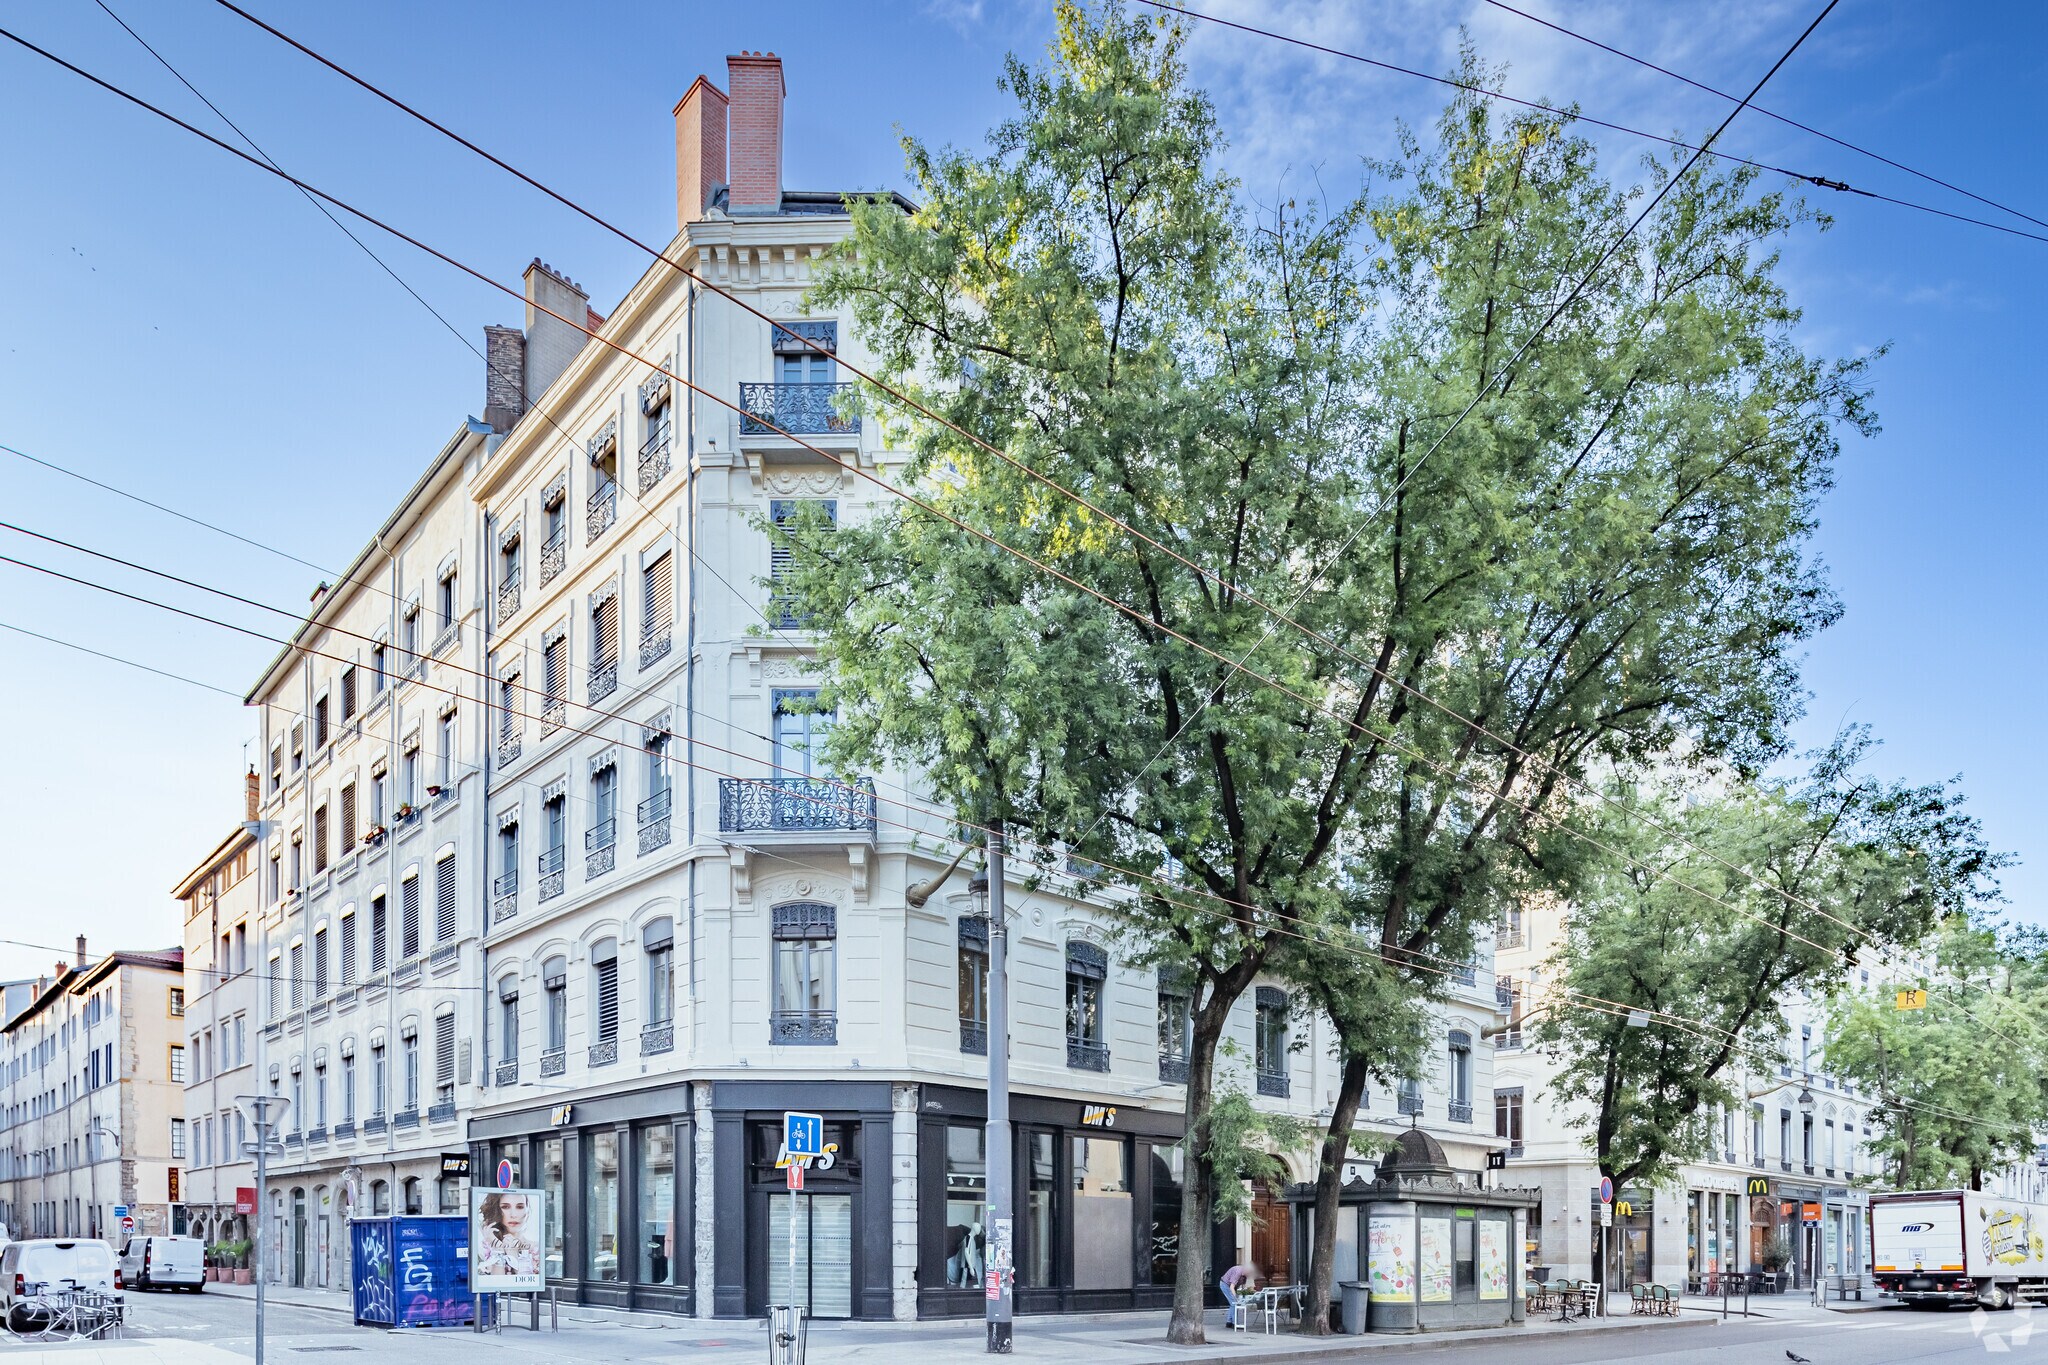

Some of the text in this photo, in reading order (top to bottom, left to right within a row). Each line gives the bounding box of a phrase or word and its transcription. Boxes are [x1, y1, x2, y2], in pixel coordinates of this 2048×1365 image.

[1906, 991, 1916, 1004] R
[1082, 1104, 1117, 1127] DM'S
[443, 1158, 469, 1172] DM'S
[1492, 1156, 1502, 1166] IT
[1901, 1225, 1922, 1233] MB
